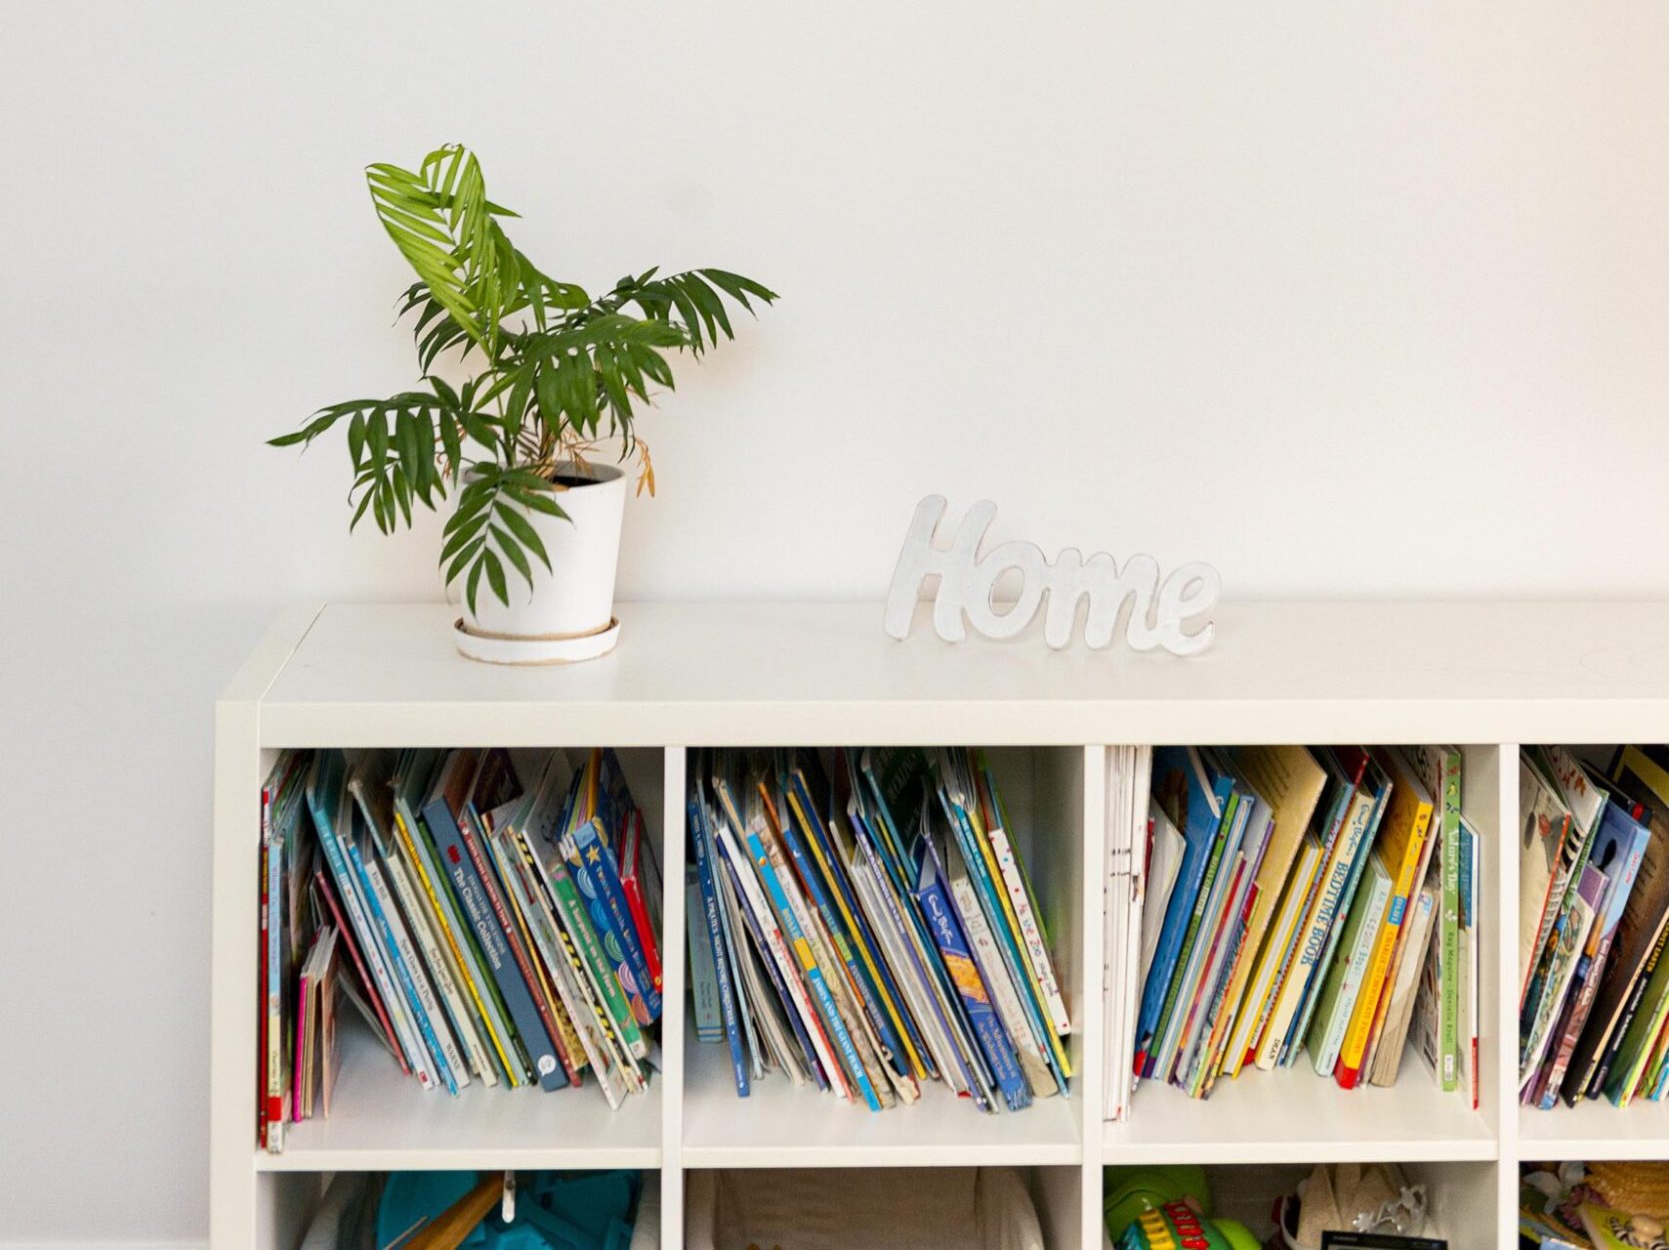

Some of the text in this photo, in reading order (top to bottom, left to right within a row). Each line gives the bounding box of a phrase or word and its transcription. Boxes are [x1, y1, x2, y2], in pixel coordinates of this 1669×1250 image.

[884, 494, 1222, 656] Home
[1444, 827, 1458, 894] Nature's Day
[567, 898, 577, 907] A
[1316, 860, 1349, 926] BEDTIME
[1389, 896, 1405, 923] DAHL
[451, 867, 505, 970] The Classic Collection
[570, 906, 593, 945] Surprise
[1300, 926, 1325, 968] BOOK
[1378, 930, 1394, 964] CHARLIE
[1645, 946, 1661, 973] EARTH
[811, 976, 829, 1002] JAMES
[822, 1000, 836, 1018] AND
[829, 1015, 843, 1032] THE
[836, 1029, 853, 1055] GIANT
[1362, 974, 1381, 1019] CHOCOLATE
[1352, 1020, 1368, 1054] FACTORY
